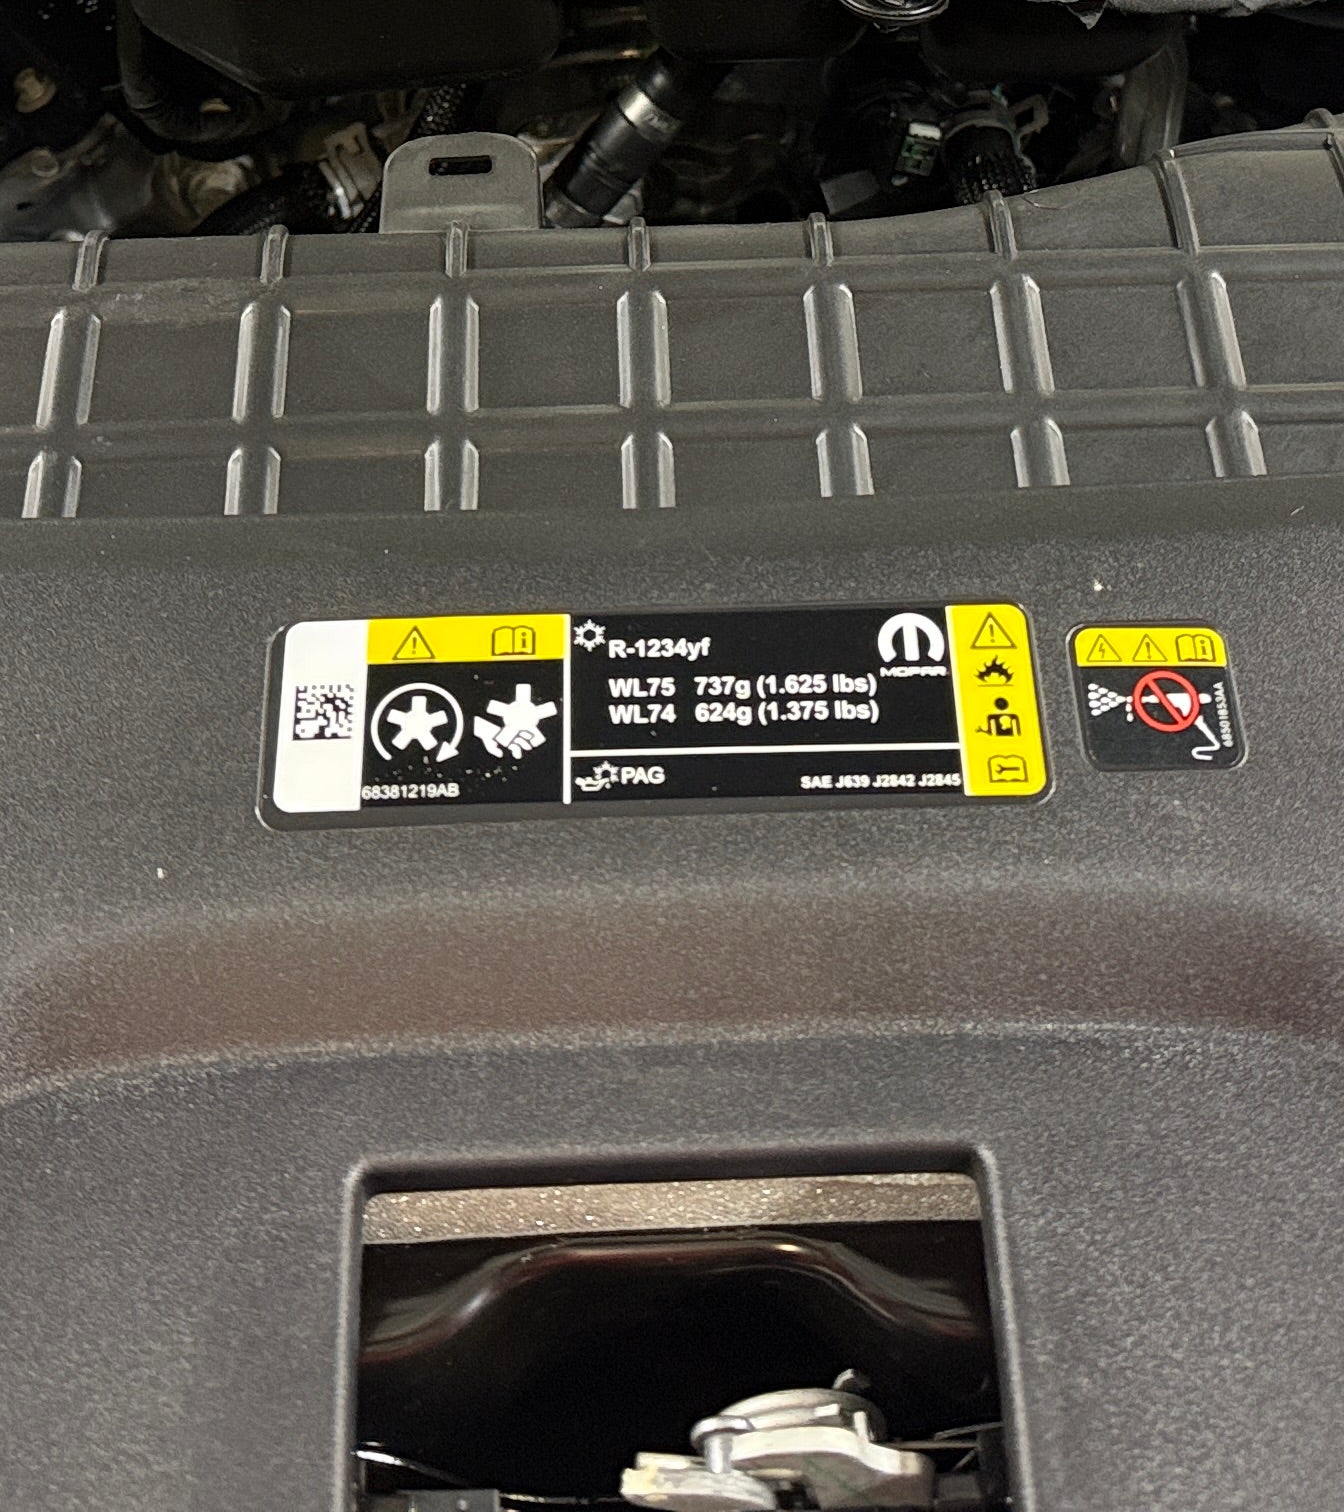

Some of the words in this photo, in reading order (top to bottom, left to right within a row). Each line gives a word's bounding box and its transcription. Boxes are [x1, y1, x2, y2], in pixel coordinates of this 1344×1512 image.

[608, 636, 712, 662] R-1234yf
[879, 666, 949, 679] MOPAR
[608, 677, 676, 699] WL75
[694, 675, 751, 699] 737g
[756, 674, 827, 699] (1.625
[831, 673, 878, 698] lbs)
[608, 703, 677, 725] WL74
[694, 702, 752, 726] 624g
[757, 700, 829, 726] (1.375
[833, 699, 880, 724] lbs)
[621, 766, 666, 785] PAG
[800, 775, 833, 790] SAE
[835, 774, 870, 788] J639
[361, 782, 460, 800] 68381219AB
